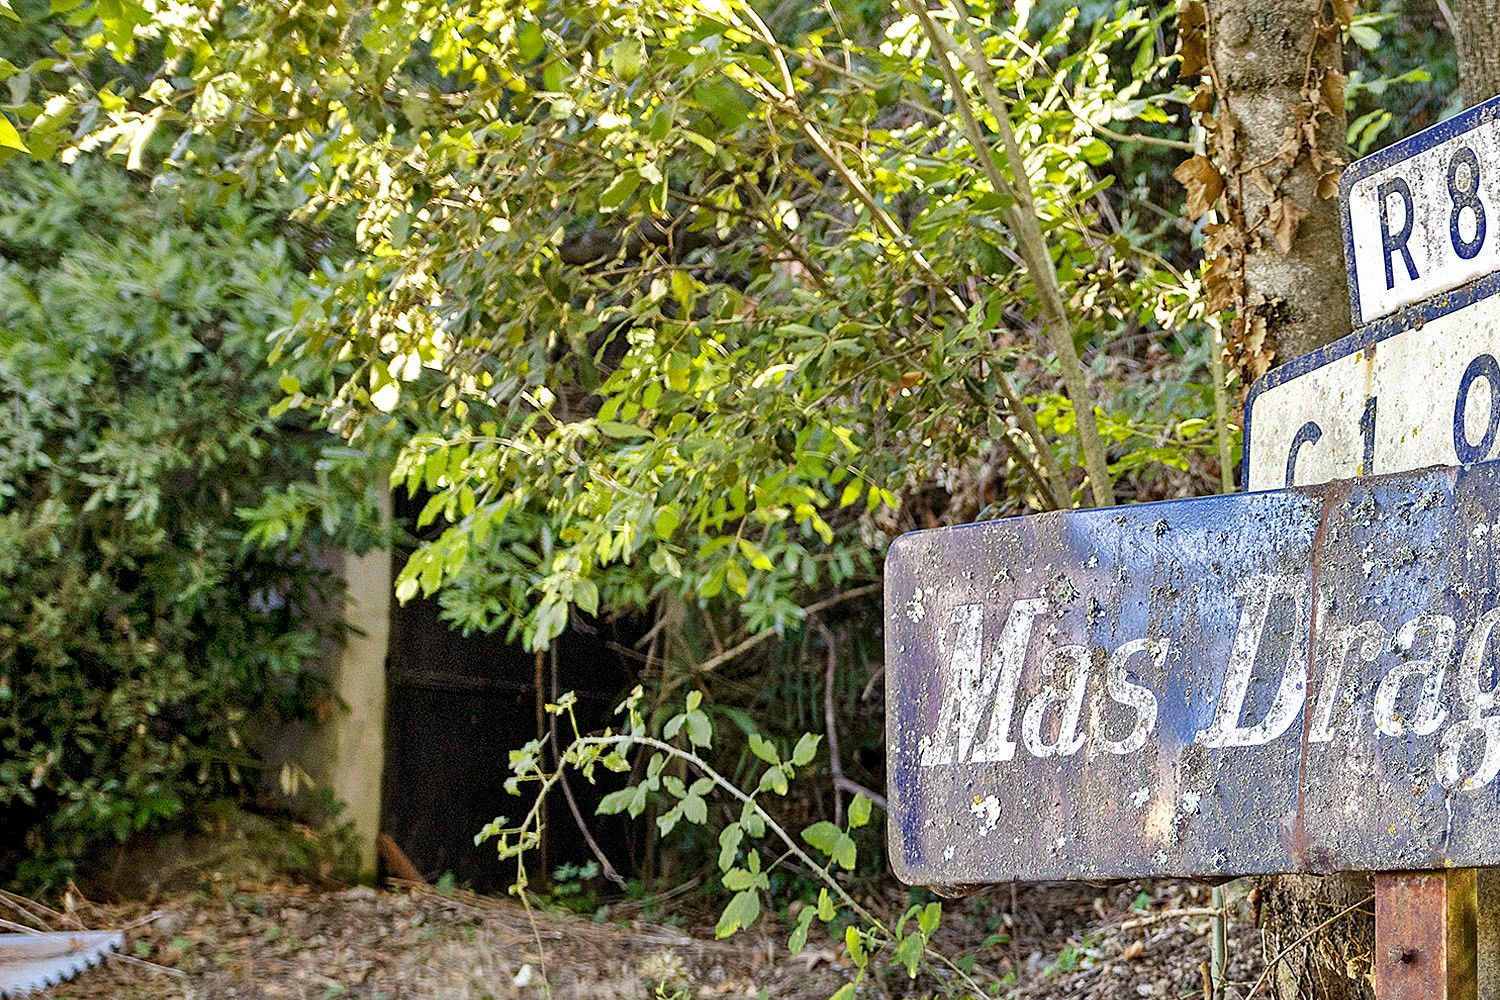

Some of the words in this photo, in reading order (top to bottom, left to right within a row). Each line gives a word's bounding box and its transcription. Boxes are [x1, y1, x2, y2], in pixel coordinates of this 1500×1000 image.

[1376, 176, 1420, 291] R
[1447, 146, 1487, 260] 8
[1358, 395, 1378, 478] 1
[920, 597, 1170, 767] Mas
